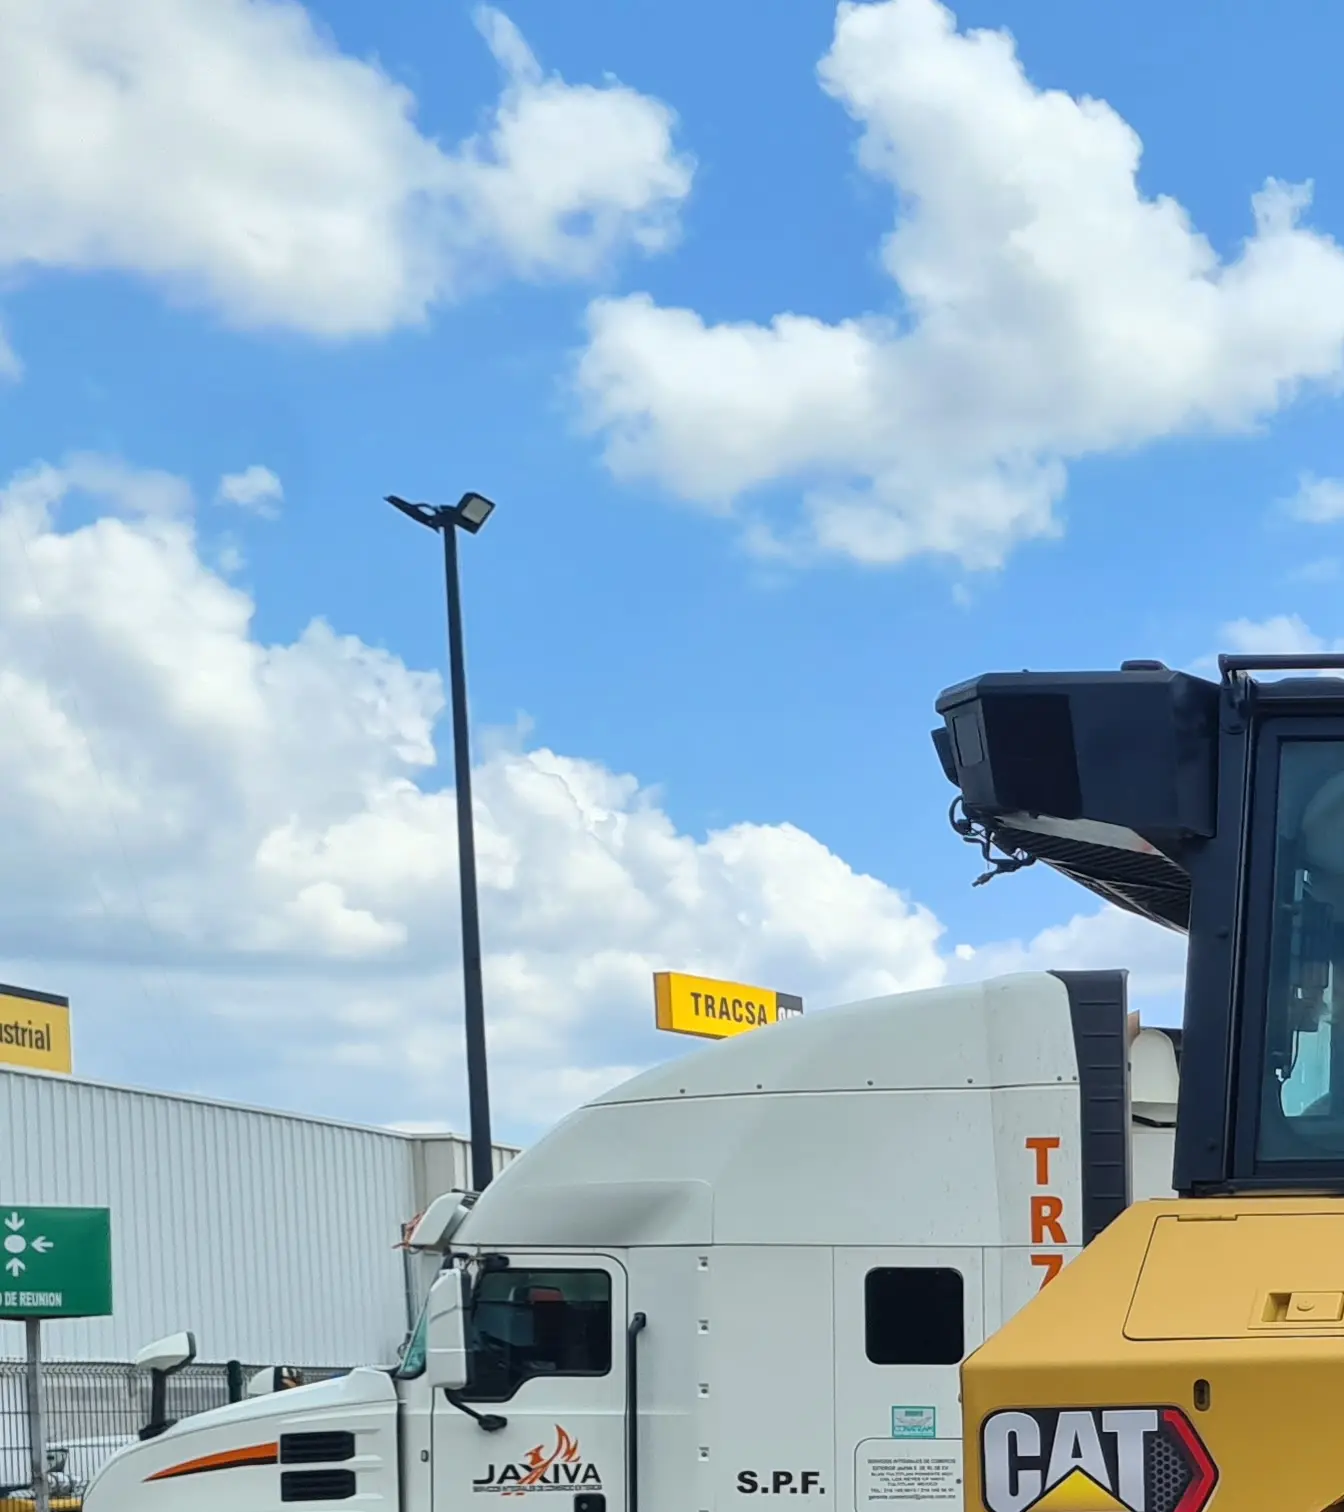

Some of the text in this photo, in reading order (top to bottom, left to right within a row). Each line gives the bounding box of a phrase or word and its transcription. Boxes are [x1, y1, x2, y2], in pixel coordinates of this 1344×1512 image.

[690, 991, 768, 1026] TRACSA
[4, 1291, 18, 1306] DE
[19, 1291, 62, 1307] REUNION
[472, 1463, 602, 1485] JAXIVA
[736, 1470, 826, 1495] S.P.F.
